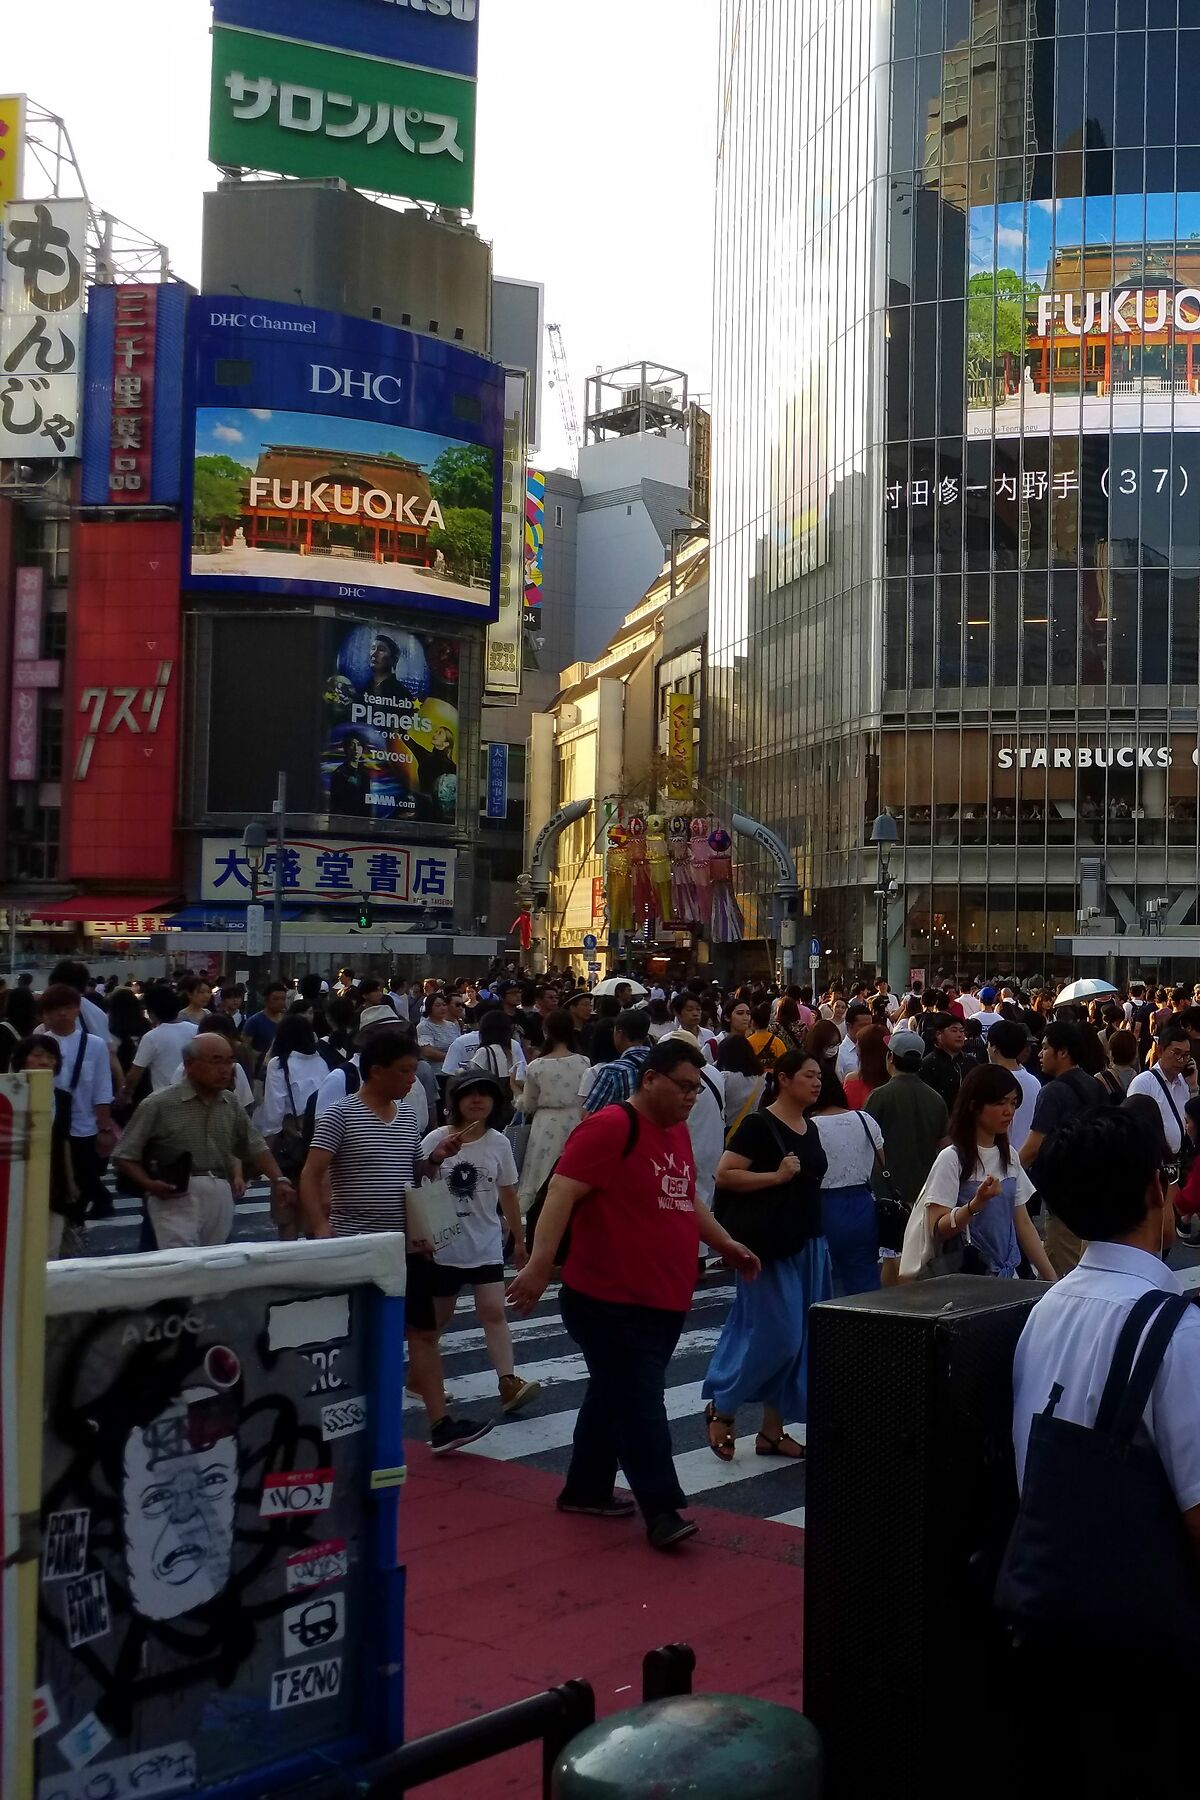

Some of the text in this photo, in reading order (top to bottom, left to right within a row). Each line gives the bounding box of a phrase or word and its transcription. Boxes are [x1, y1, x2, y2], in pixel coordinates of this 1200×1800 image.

[224, 70, 464, 163] サロンパス
[1, 204, 81, 453] もんじゃ
[210, 312, 317, 334] DHC Channel
[109, 291, 148, 492] 三千里薬品
[308, 363, 402, 405] DHC
[250, 477, 447, 531] FUKUOKA
[338, 586, 366, 599] DHC
[351, 703, 432, 733] Planets
[363, 691, 412, 710] teamLab
[73, 660, 173, 781] クスリ
[375, 730, 410, 741] TOKYO
[369, 749, 413, 764] TOYOSU
[997, 746, 1173, 769] STARBUCKS
[364, 793, 416, 809] DMM.com
[213, 849, 447, 895] 大盛堂書店
[274, 1661, 340, 1708] TECNO
